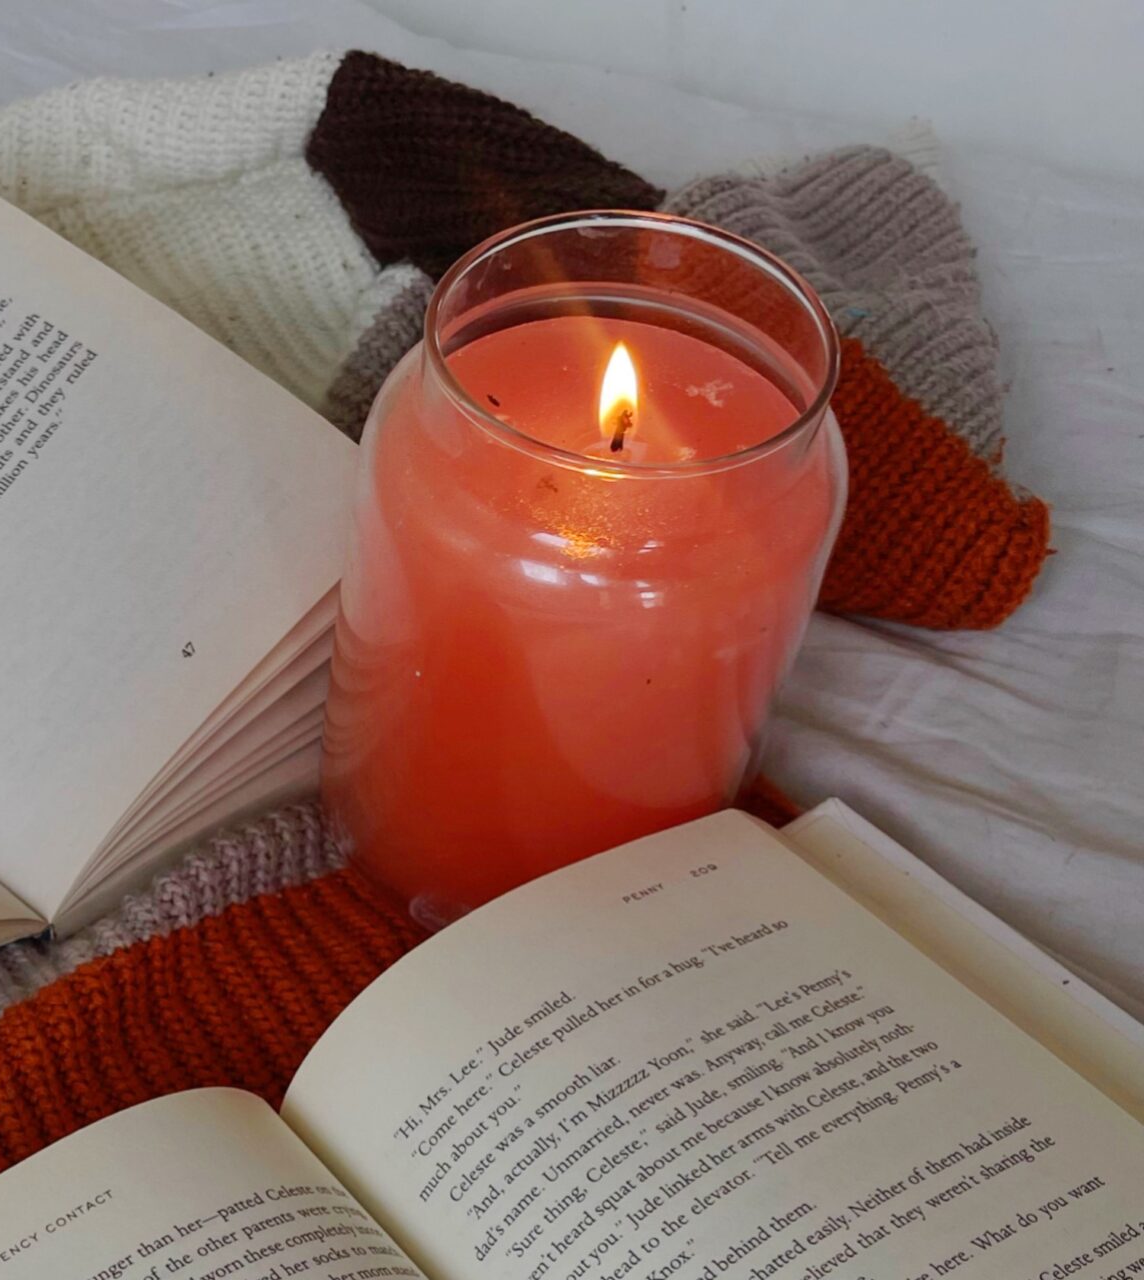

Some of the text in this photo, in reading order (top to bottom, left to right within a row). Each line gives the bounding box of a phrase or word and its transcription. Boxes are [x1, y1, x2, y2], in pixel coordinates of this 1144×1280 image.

[14, 418, 39, 447] and
[36, 387, 66, 417] they
[65, 348, 99, 385] ruled
[182, 641, 196, 658] 47
[621, 863, 719, 905] PENNY 209
[449, 1056, 622, 1203] Celeste was a smooth liar.
[44, 1188, 113, 1234] CONTACT
[805, 1214, 852, 1246] easily.
[847, 1180, 908, 1218] Neither
[907, 1166, 927, 1185] of
[924, 1150, 966, 1175] them
[958, 1132, 993, 1156] had
[989, 1116, 1033, 1142] inside
[136, 1234, 175, 1258] than
[264, 1184, 315, 1201] Celeste
[164, 1254, 194, 1274] the
[196, 1231, 239, 1257] other
[240, 1212, 296, 1241] parents
[296, 1205, 331, 1218] were
[711, 1225, 772, 1272] behind
[768, 1202, 818, 1233] them.
